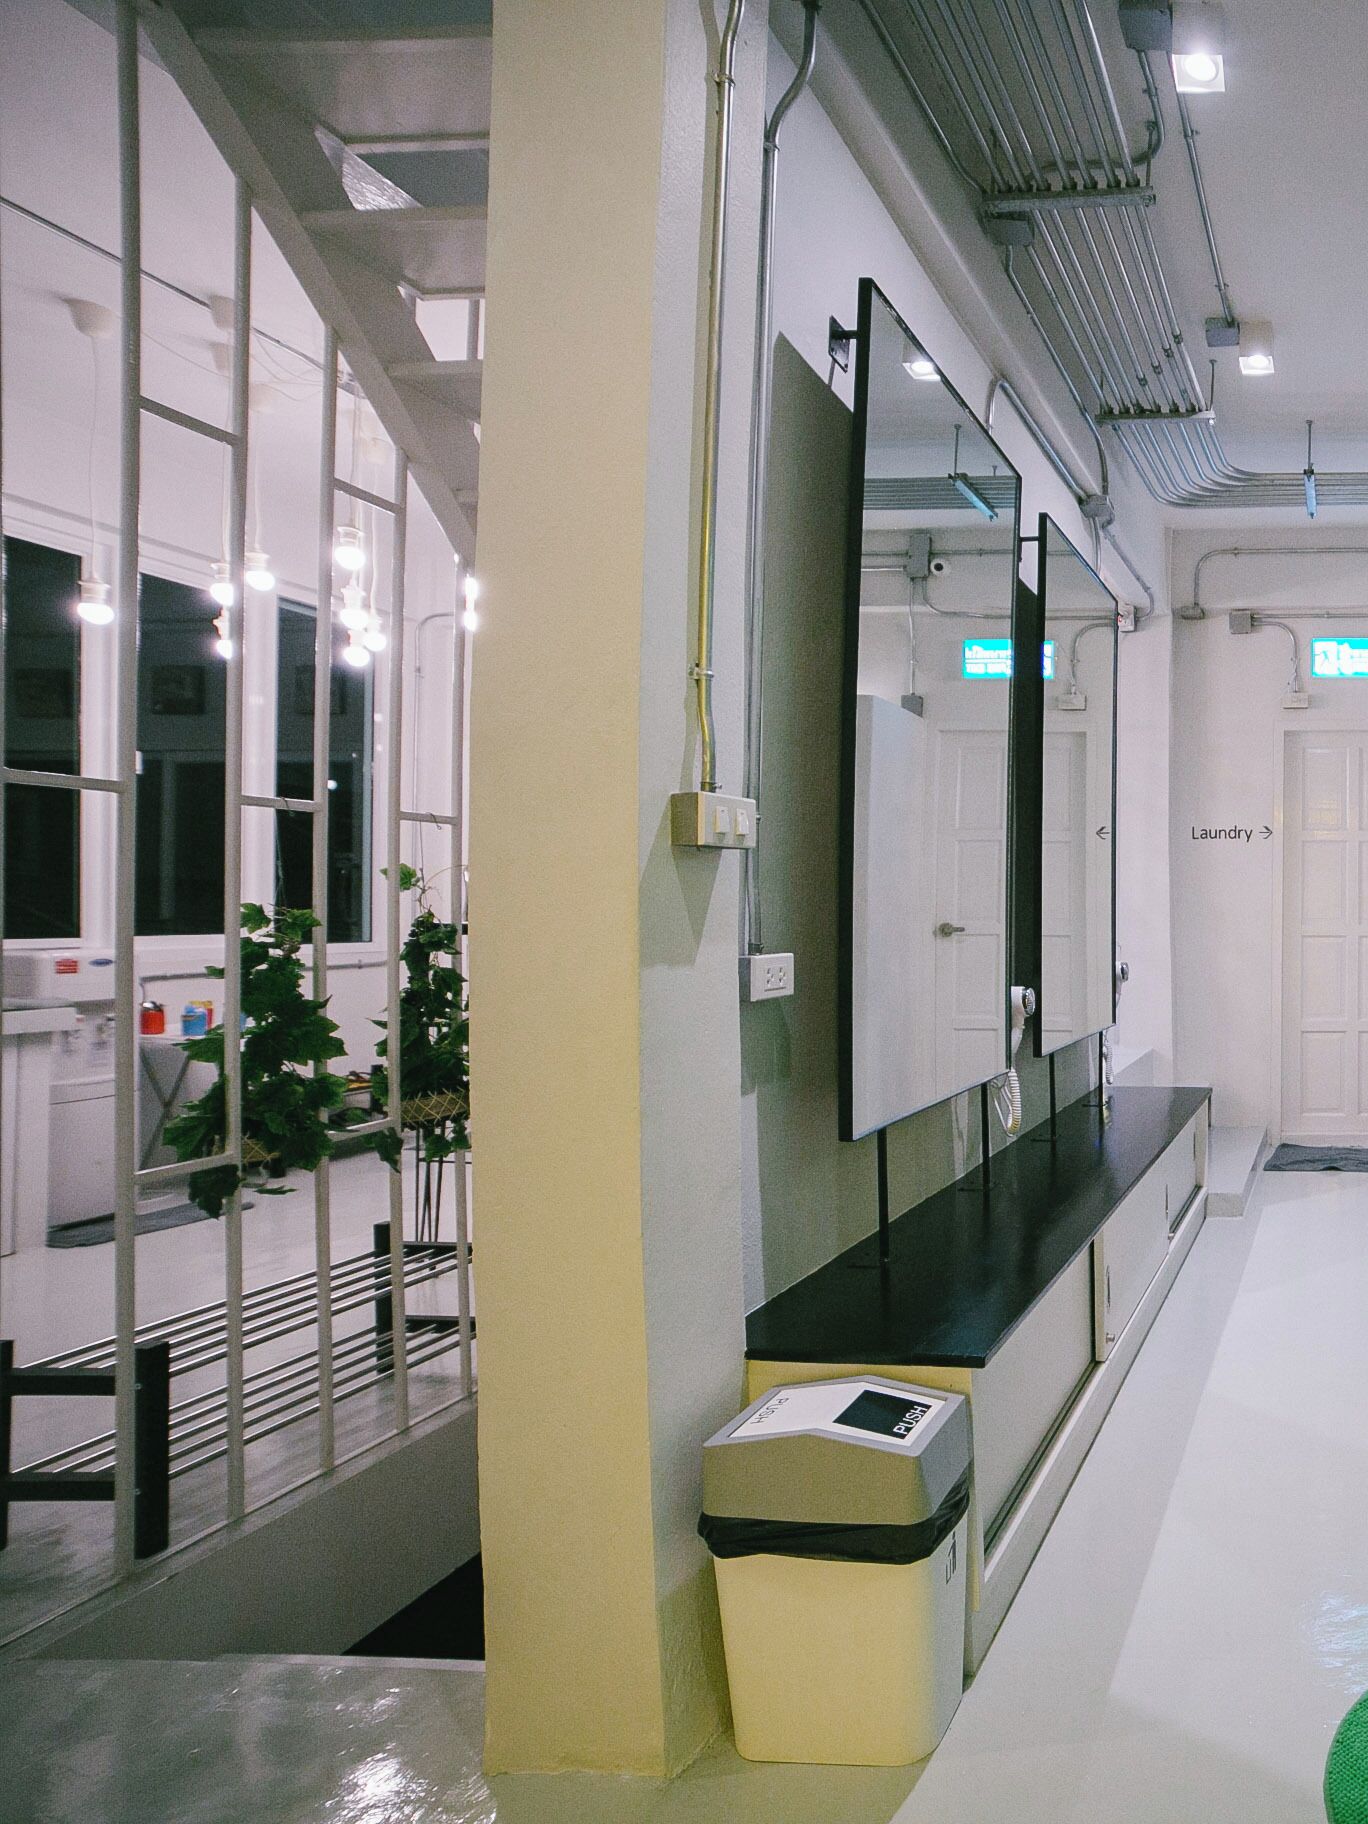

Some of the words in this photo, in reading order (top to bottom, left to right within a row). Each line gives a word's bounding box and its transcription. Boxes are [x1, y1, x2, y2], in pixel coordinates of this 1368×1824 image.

[1191, 825, 1253, 843] Laundry
[750, 1397, 790, 1425] PUSH
[893, 1405, 928, 1435] PUSH
